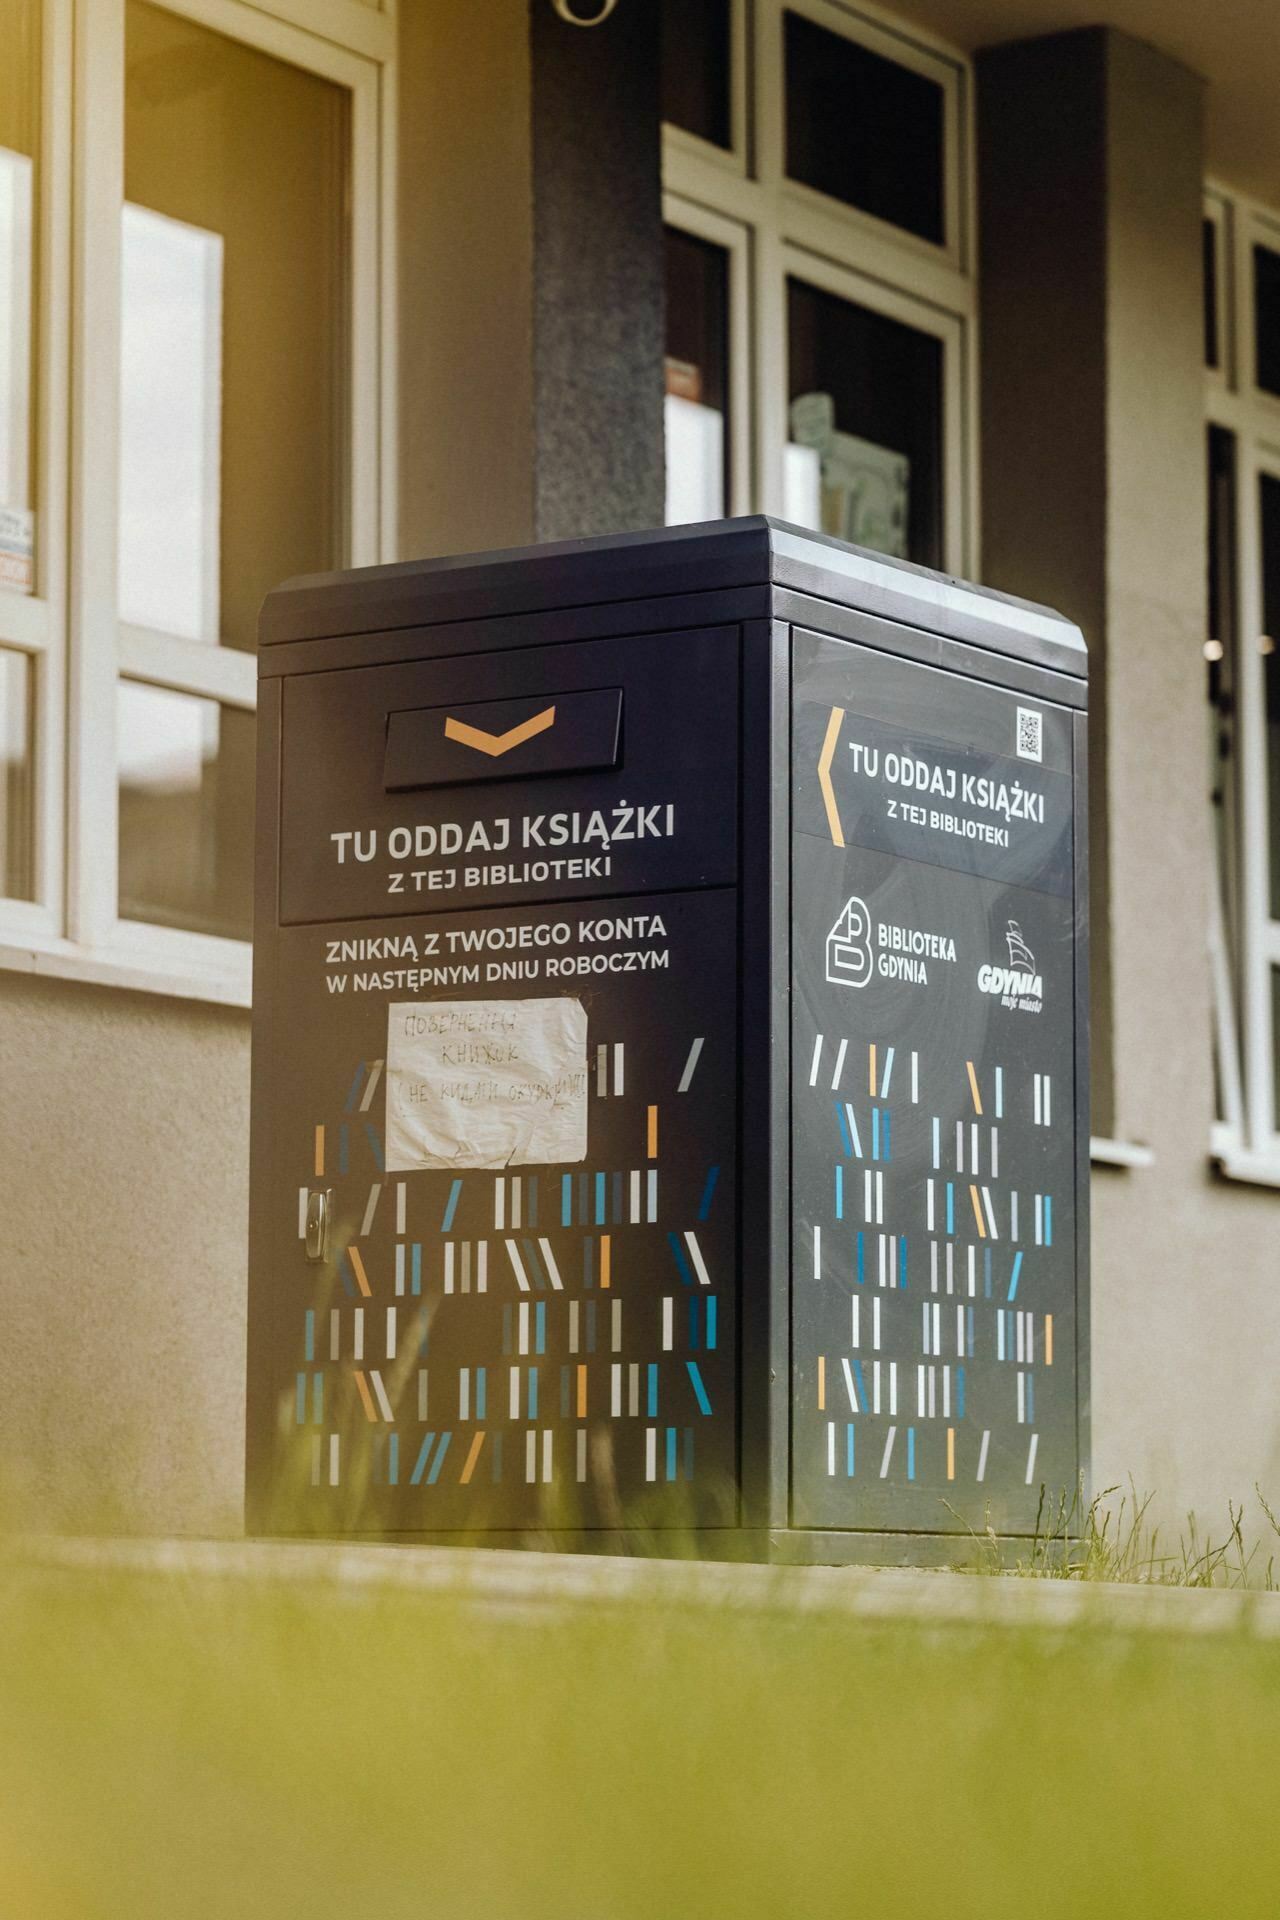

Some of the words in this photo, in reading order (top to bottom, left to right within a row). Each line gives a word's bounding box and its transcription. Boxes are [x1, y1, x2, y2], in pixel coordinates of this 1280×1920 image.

[849, 742, 879, 778] TU
[884, 753, 957, 799] ODDAJ
[962, 773, 1044, 823] KSIĄŻKI
[331, 829, 377, 864] TU
[388, 818, 510, 860] ODDAJ
[523, 799, 674, 851] KSIĄŻKI
[887, 799, 898, 819] Z
[900, 802, 927, 826] TEJ
[930, 810, 1009, 848] BIBLIOTEKI
[388, 873, 405, 894] Z
[411, 868, 456, 892] TEJ
[465, 856, 611, 888] BIBLIOTEKI
[326, 933, 419, 963] ZNIKNĄ
[424, 933, 440, 956] Z
[445, 922, 571, 954] TWOJEGO
[578, 914, 667, 943] KONTA
[878, 923, 957, 963] BIBLIOTEKA
[326, 975, 345, 994] W
[353, 964, 480, 992] NASTĘPNYM
[486, 960, 539, 983] DNIU
[546, 949, 670, 979] ROBOCZYM
[878, 953, 928, 985] GDYNIA
[977, 964, 1043, 999] GDYNIA
[409, 1083, 429, 1104] НЕ
